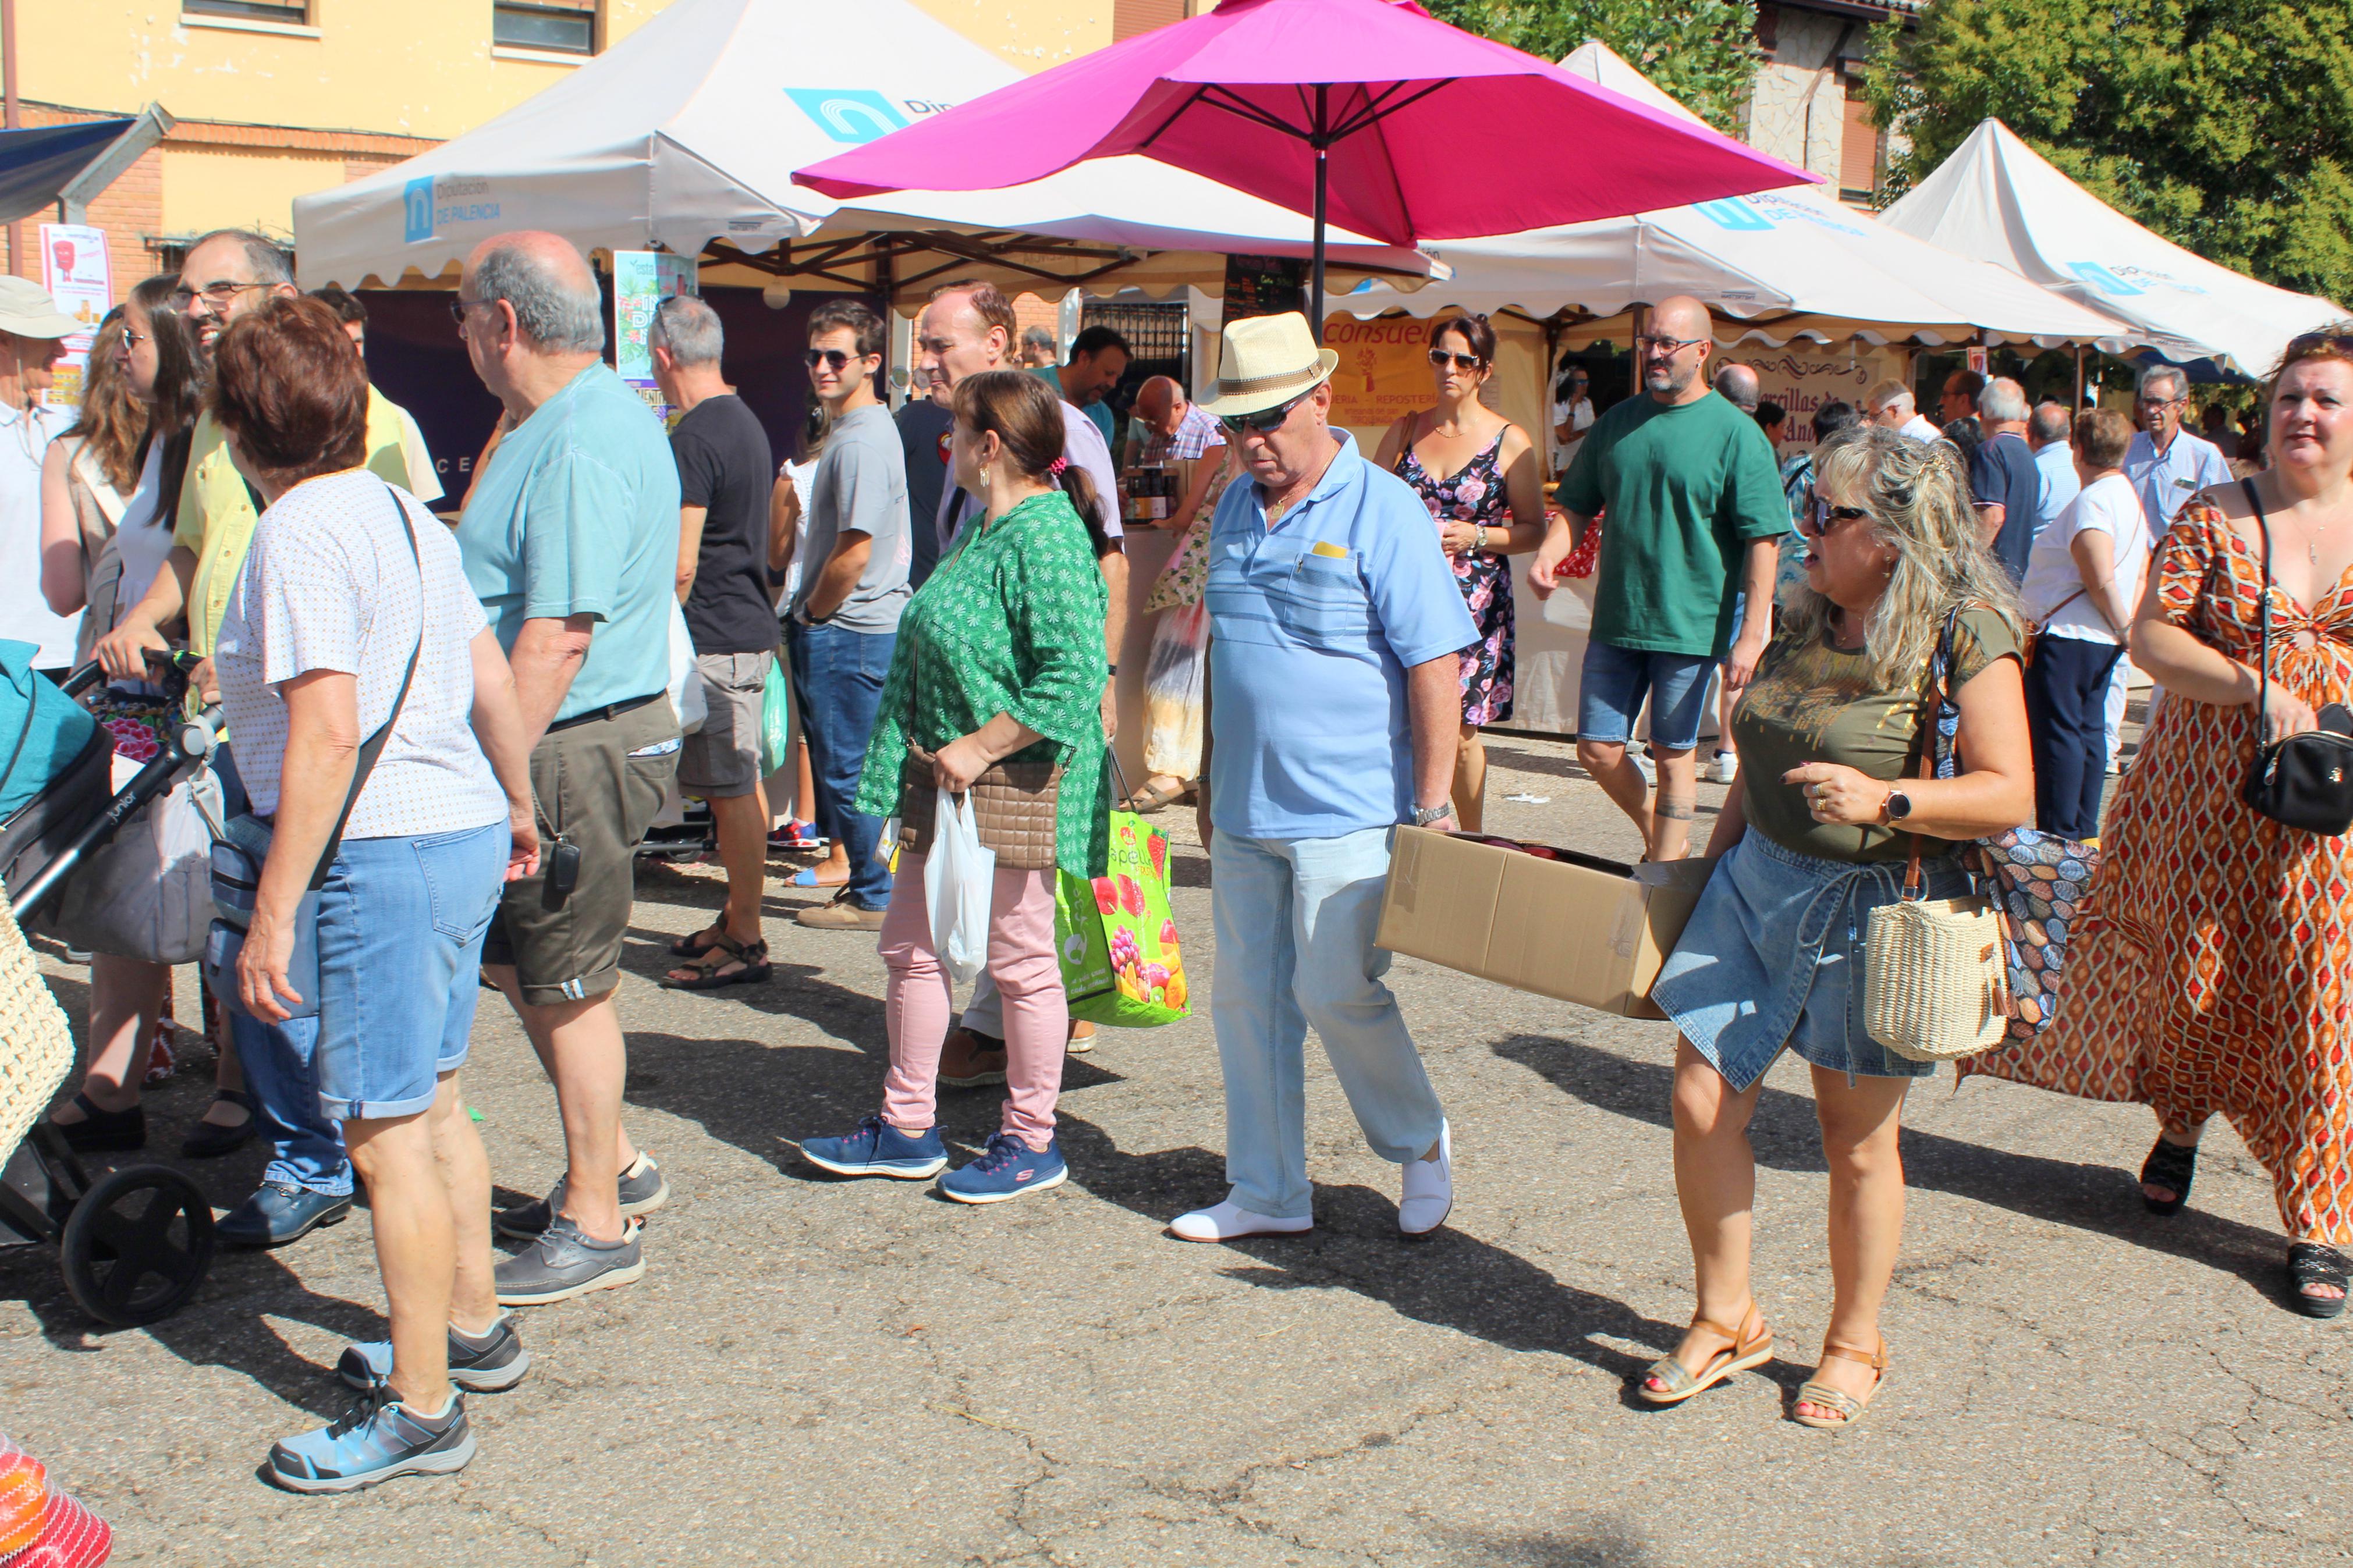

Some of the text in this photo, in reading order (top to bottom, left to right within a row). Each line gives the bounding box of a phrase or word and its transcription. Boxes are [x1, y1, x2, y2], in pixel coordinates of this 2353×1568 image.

[436, 176, 490, 201] Diputación
[436, 204, 501, 226] DE PALENCIA
[1323, 319, 1433, 345] consuel
[1330, 395, 1358, 404] DERIA
[1759, 387, 1819, 413] orcillas
[107, 790, 137, 825] junior
